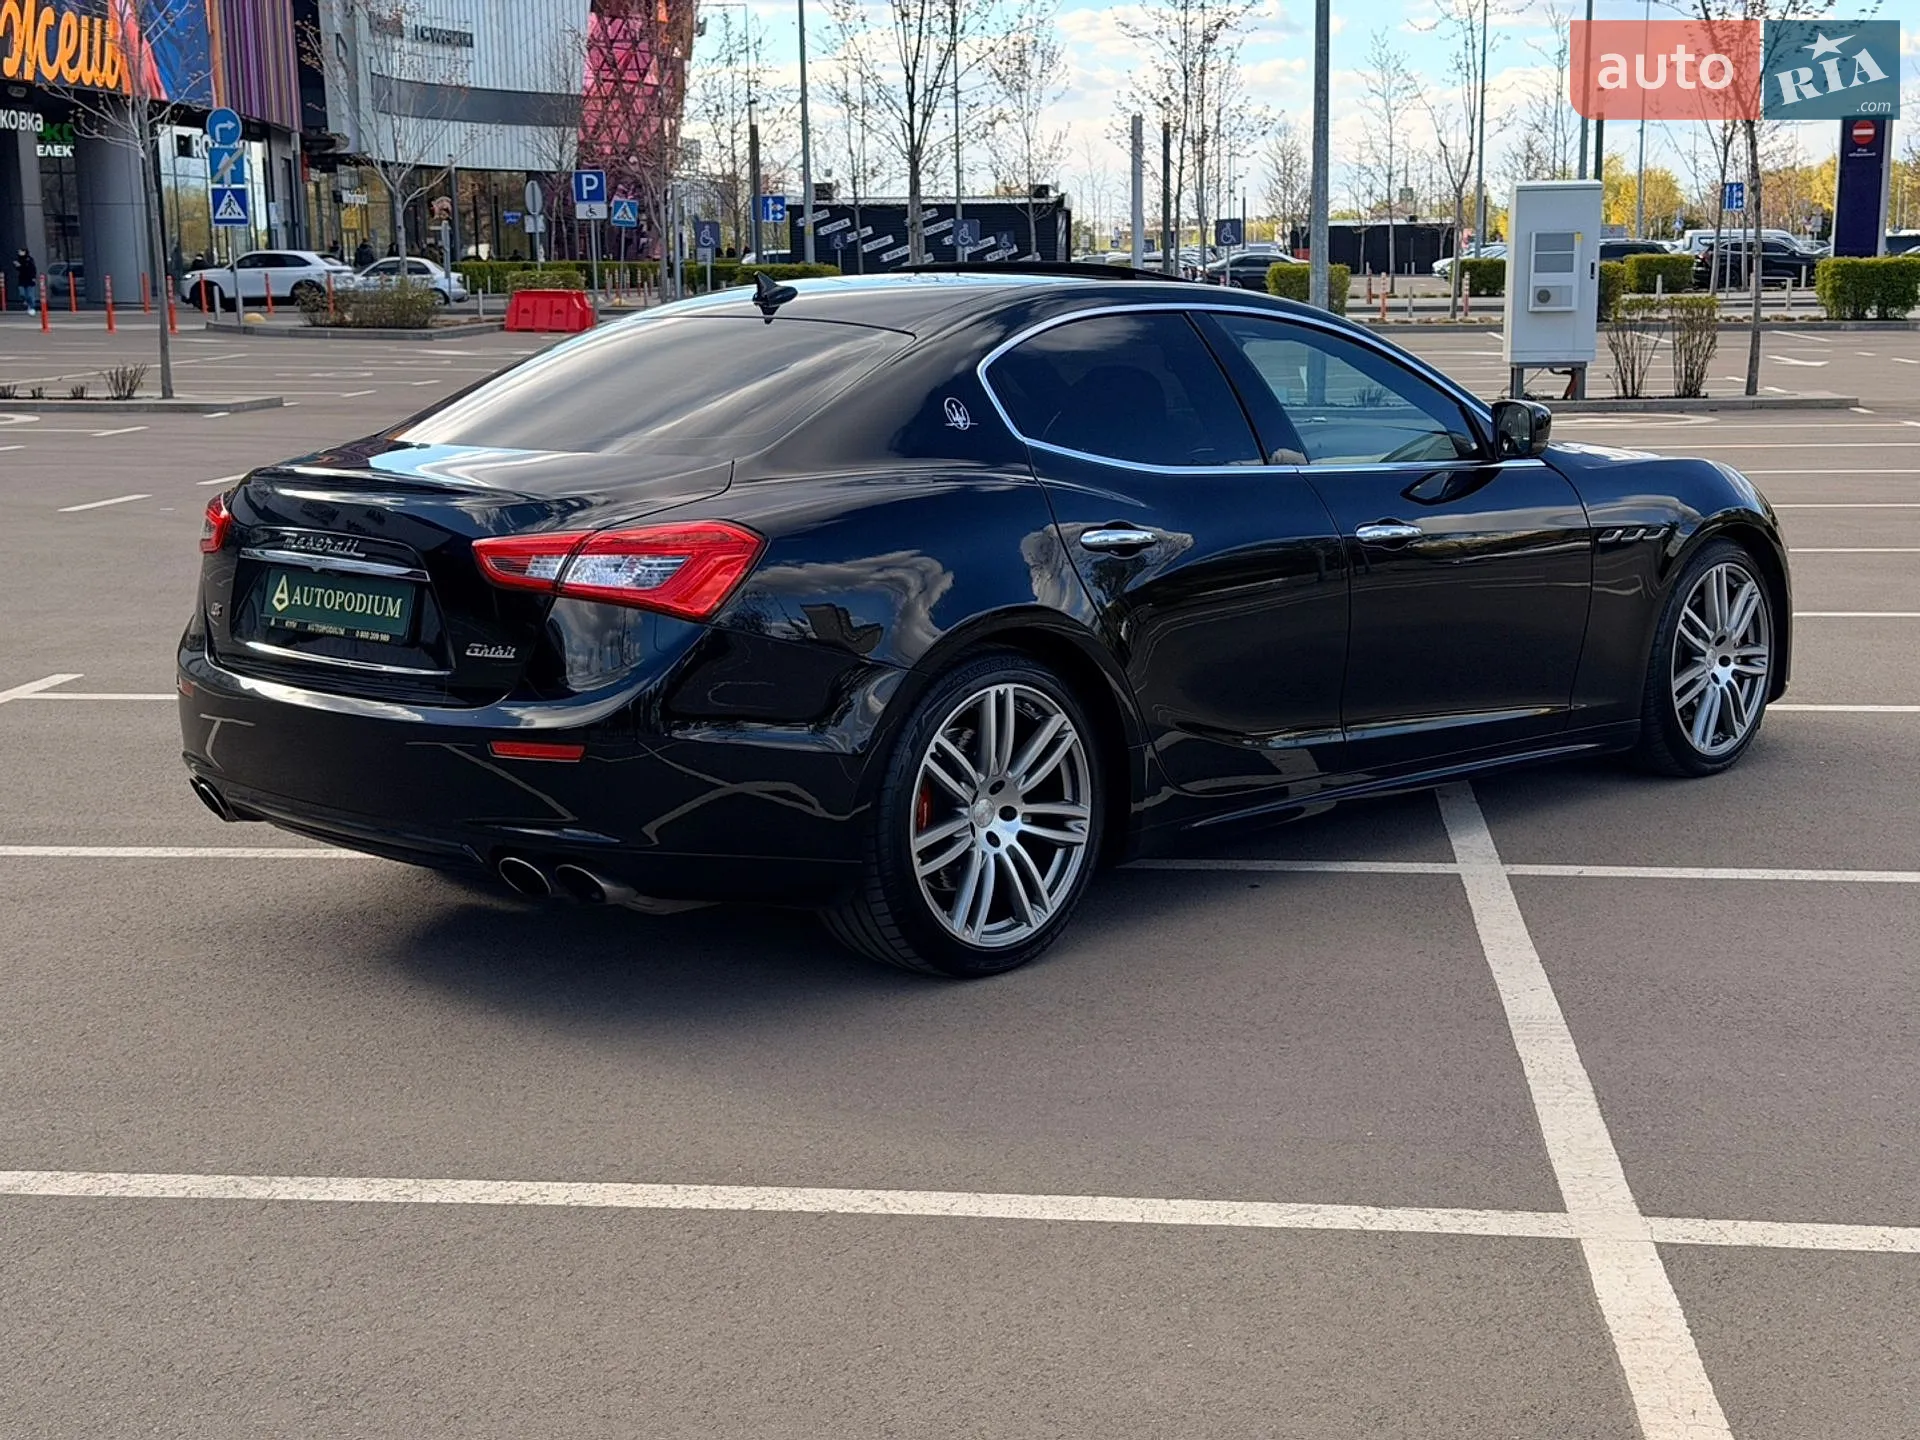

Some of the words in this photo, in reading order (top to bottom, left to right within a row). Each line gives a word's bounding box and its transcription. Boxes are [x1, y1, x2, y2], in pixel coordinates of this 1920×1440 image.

[36, 144, 75, 157] ЕЛЕК
[582, 174, 599, 199] P
[291, 585, 402, 618] AUTOPODIUM
